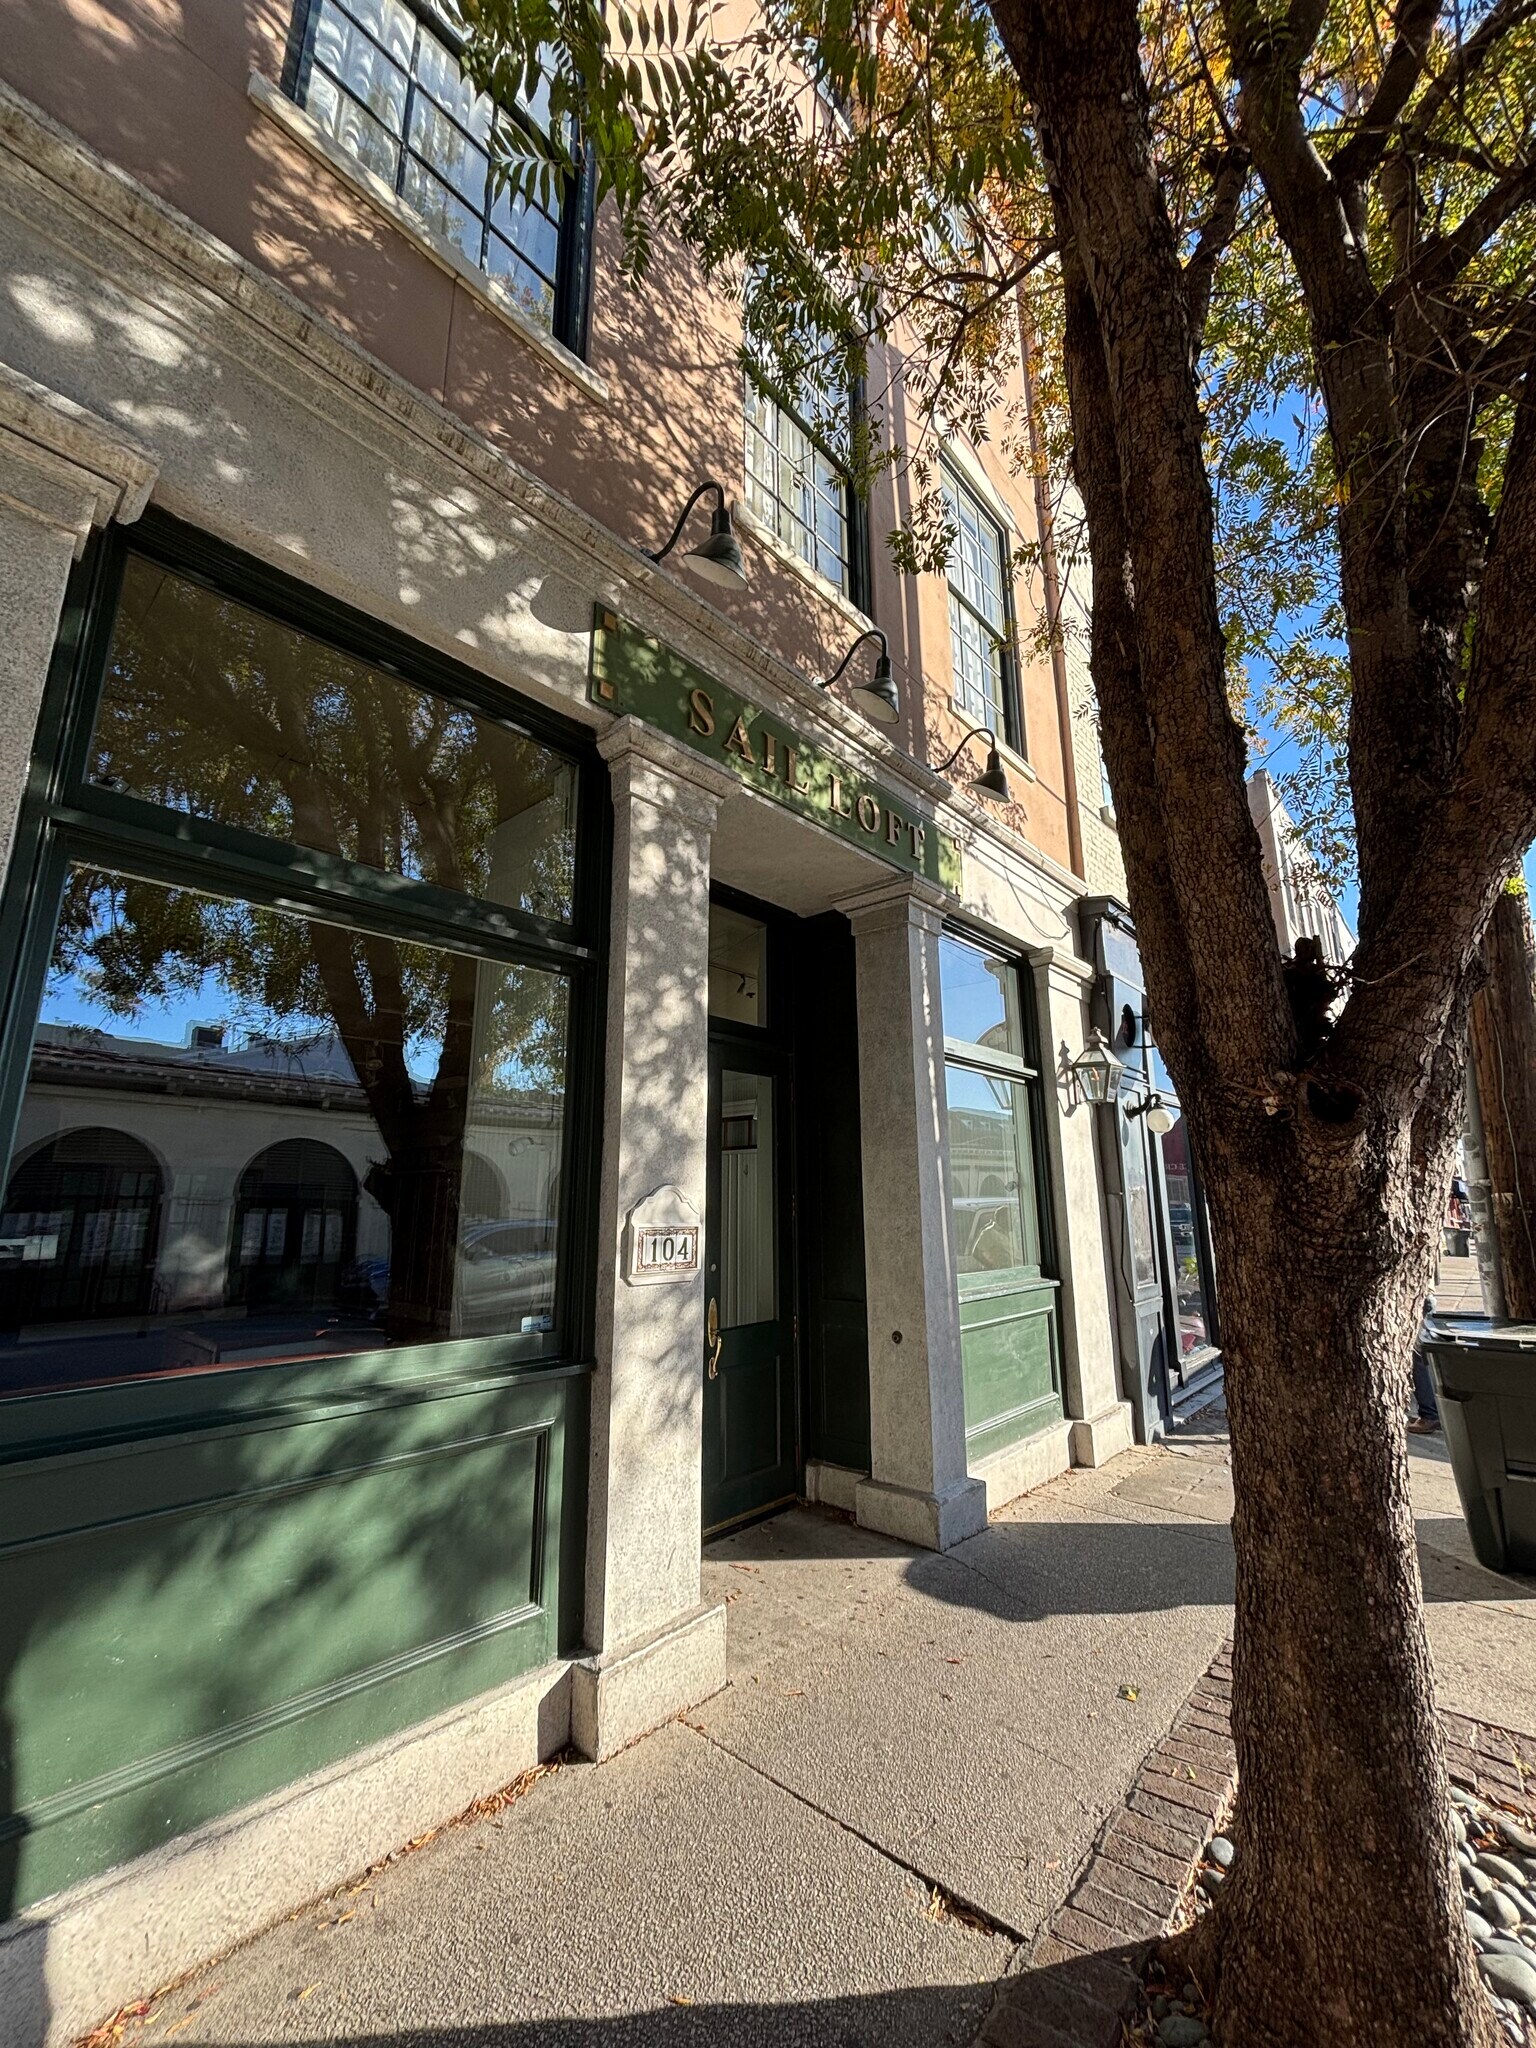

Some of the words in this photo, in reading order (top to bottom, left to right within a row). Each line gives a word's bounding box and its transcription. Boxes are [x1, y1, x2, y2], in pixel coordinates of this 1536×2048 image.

[690, 688, 810, 795] SAIL
[828, 773, 925, 860] LOFT
[651, 1237, 689, 1262] 104
